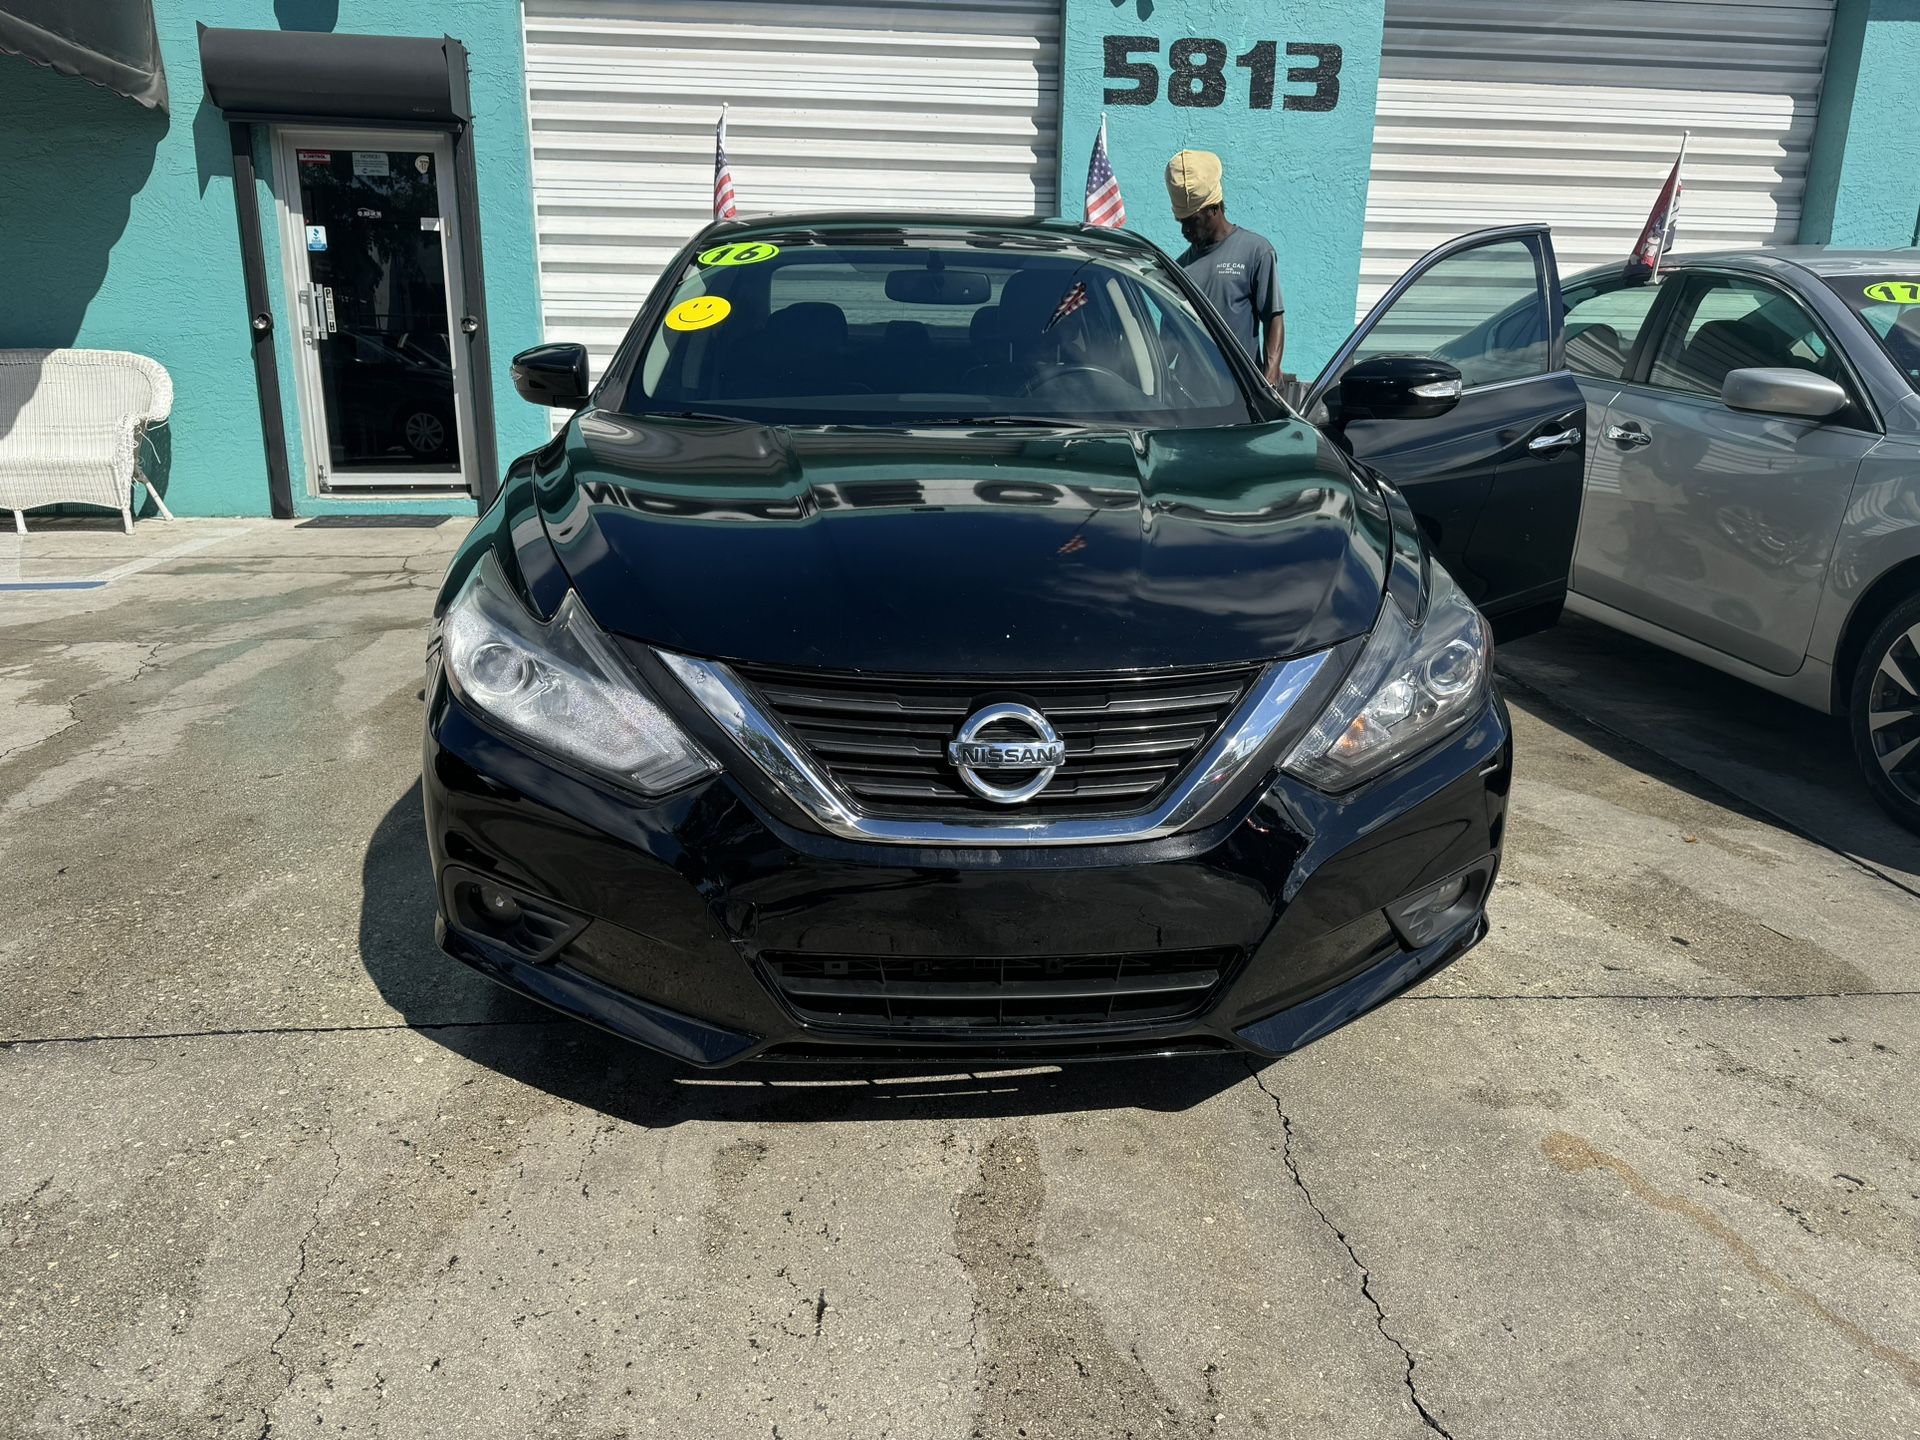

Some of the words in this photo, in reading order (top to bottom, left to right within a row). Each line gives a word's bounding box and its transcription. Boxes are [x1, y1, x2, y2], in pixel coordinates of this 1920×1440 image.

[1102, 35, 1343, 112] 5813
[710, 245, 762, 263] 16
[1878, 284, 1919, 301] 17
[961, 746, 1054, 763] NISSAN
